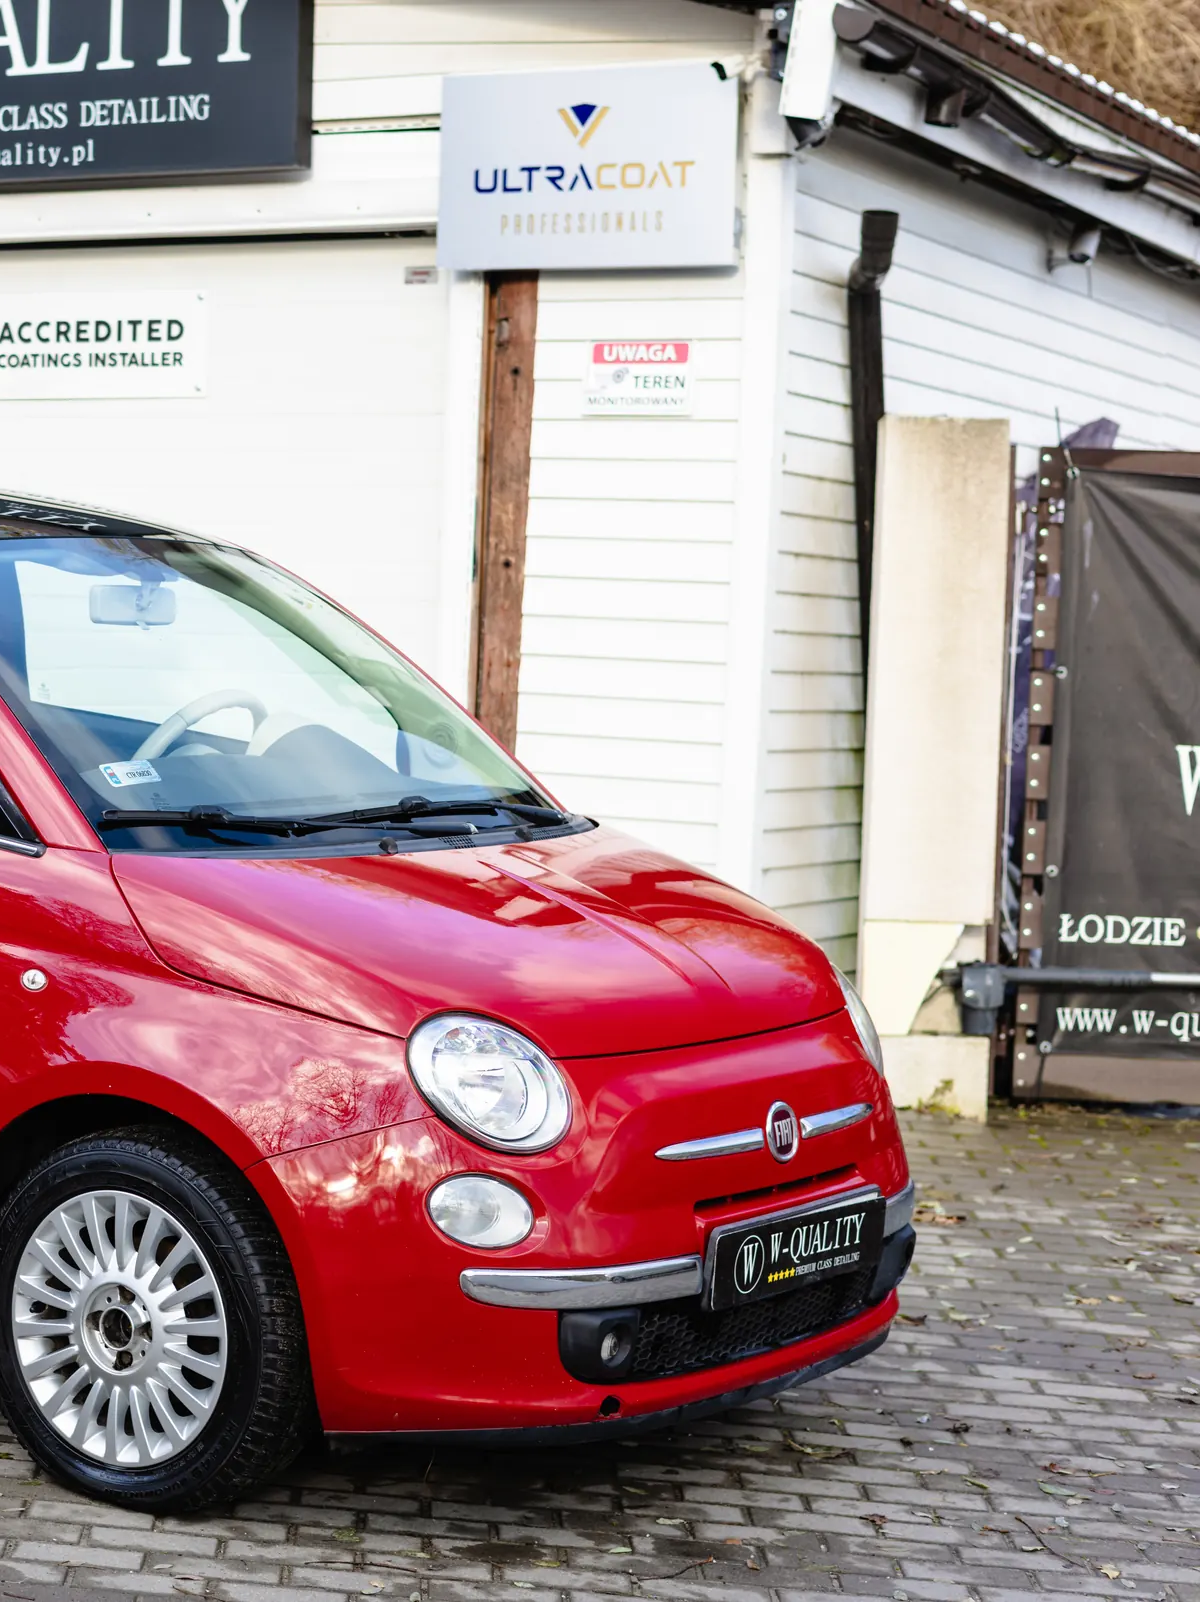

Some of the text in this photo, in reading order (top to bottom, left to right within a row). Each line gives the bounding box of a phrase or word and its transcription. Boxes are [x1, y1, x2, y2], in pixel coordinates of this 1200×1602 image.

[79, 94, 210, 127] DETAILING
[474, 161, 695, 193] ULTRACOAT
[500, 210, 664, 236] PROFESSIONALS
[88, 352, 184, 368] INSTALLER
[603, 344, 677, 362] UWAGA
[634, 376, 685, 389] TEREN
[1058, 913, 1186, 946] ŁODZIE
[773, 1118, 794, 1148] FIAT
[771, 1212, 866, 1264] W-QUALITY
[817, 1258, 833, 1271] CLASS
